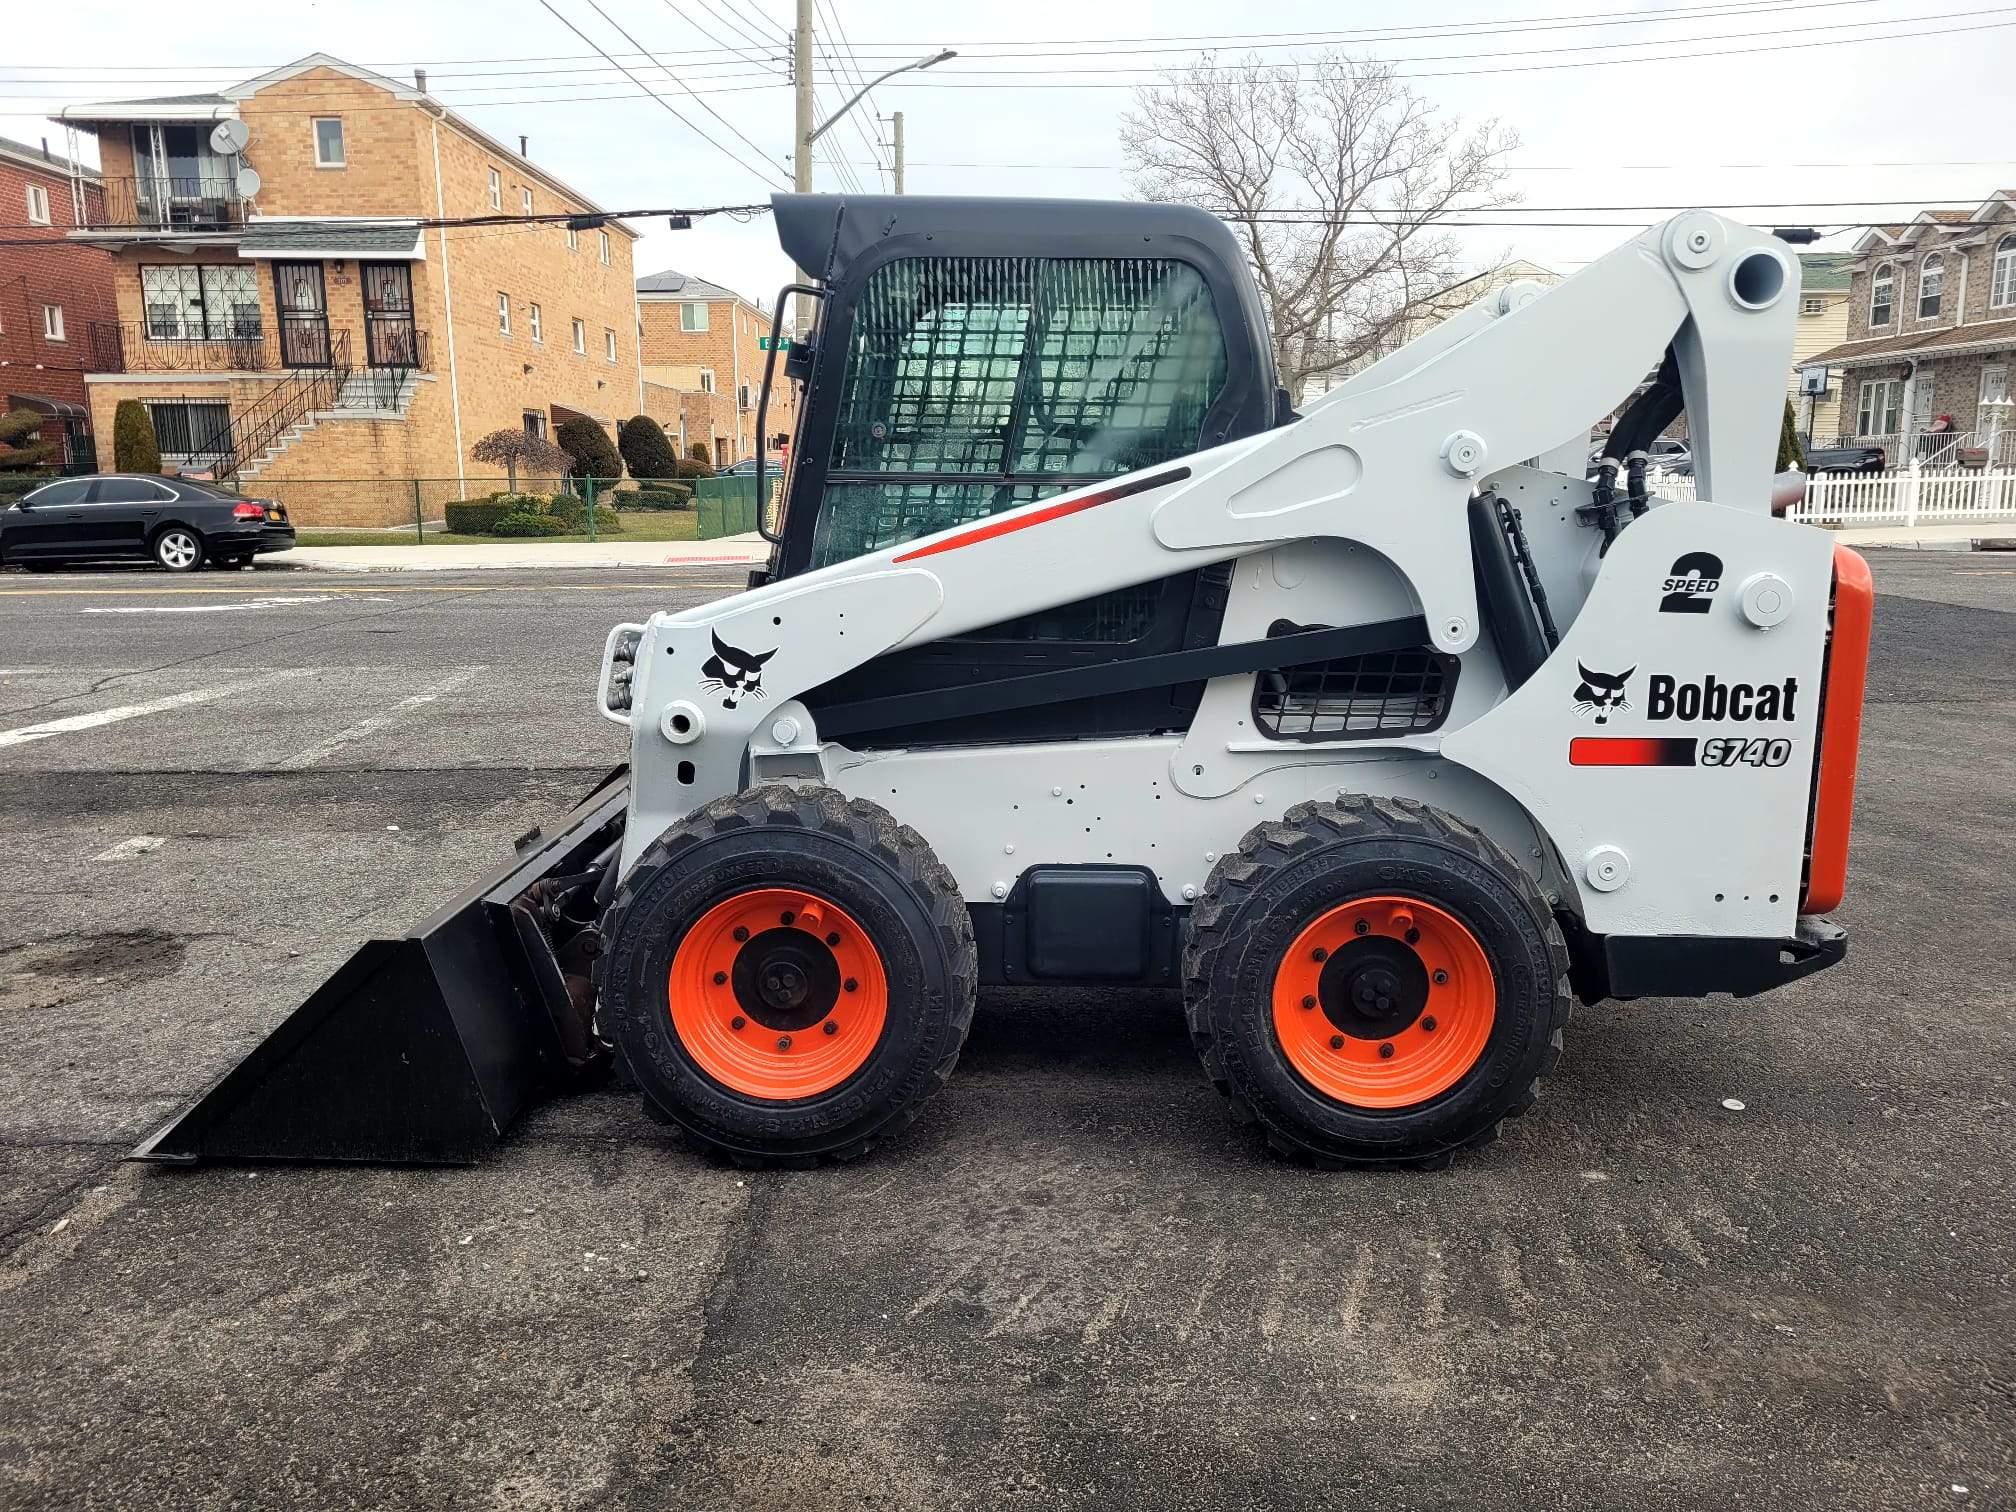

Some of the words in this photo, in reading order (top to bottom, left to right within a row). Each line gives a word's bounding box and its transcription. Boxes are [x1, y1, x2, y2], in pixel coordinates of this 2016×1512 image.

[1658, 551, 1723, 614] 2
[1662, 578, 1720, 593] SPEED
[1647, 674, 1798, 722] Bobcat
[1701, 738, 1792, 767] S740
[1264, 856, 1329, 901] TUBELESS
[1442, 855, 1504, 901] SUPER
